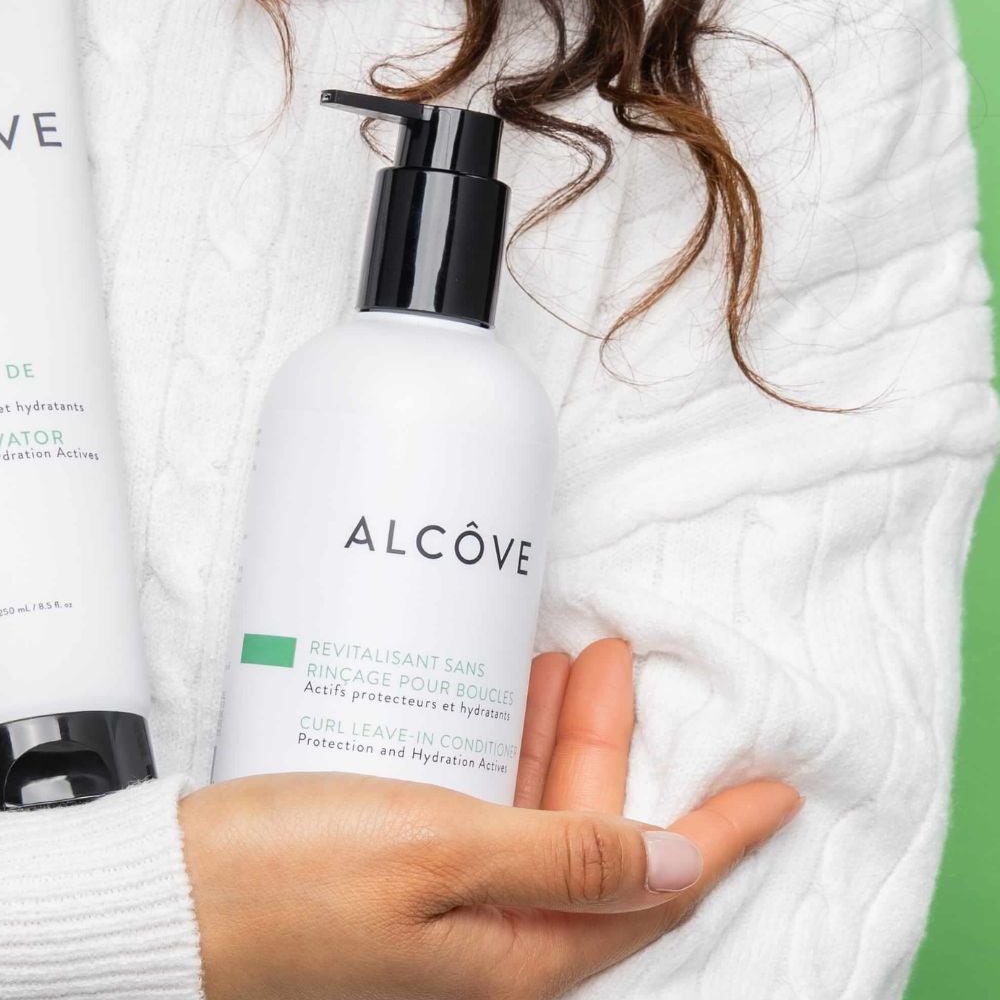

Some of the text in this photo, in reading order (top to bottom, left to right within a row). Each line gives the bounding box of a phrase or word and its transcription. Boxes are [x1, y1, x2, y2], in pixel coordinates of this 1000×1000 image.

[6, 363, 35, 379] DE
[16, 400, 84, 415] hydratants
[57, 447, 99, 461] Actives
[344, 515, 532, 576] ALCÔVE
[310, 641, 485, 677] REVITALISANT SANS
[304, 681, 510, 721] Actifs protecteurs et hydratants
[307, 664, 514, 706] RINÇAGE POUR BOUCLES
[300, 716, 344, 734] CURL
[352, 722, 434, 746] LEAVE-IN
[298, 733, 508, 774] Protection and Hydration Actives
